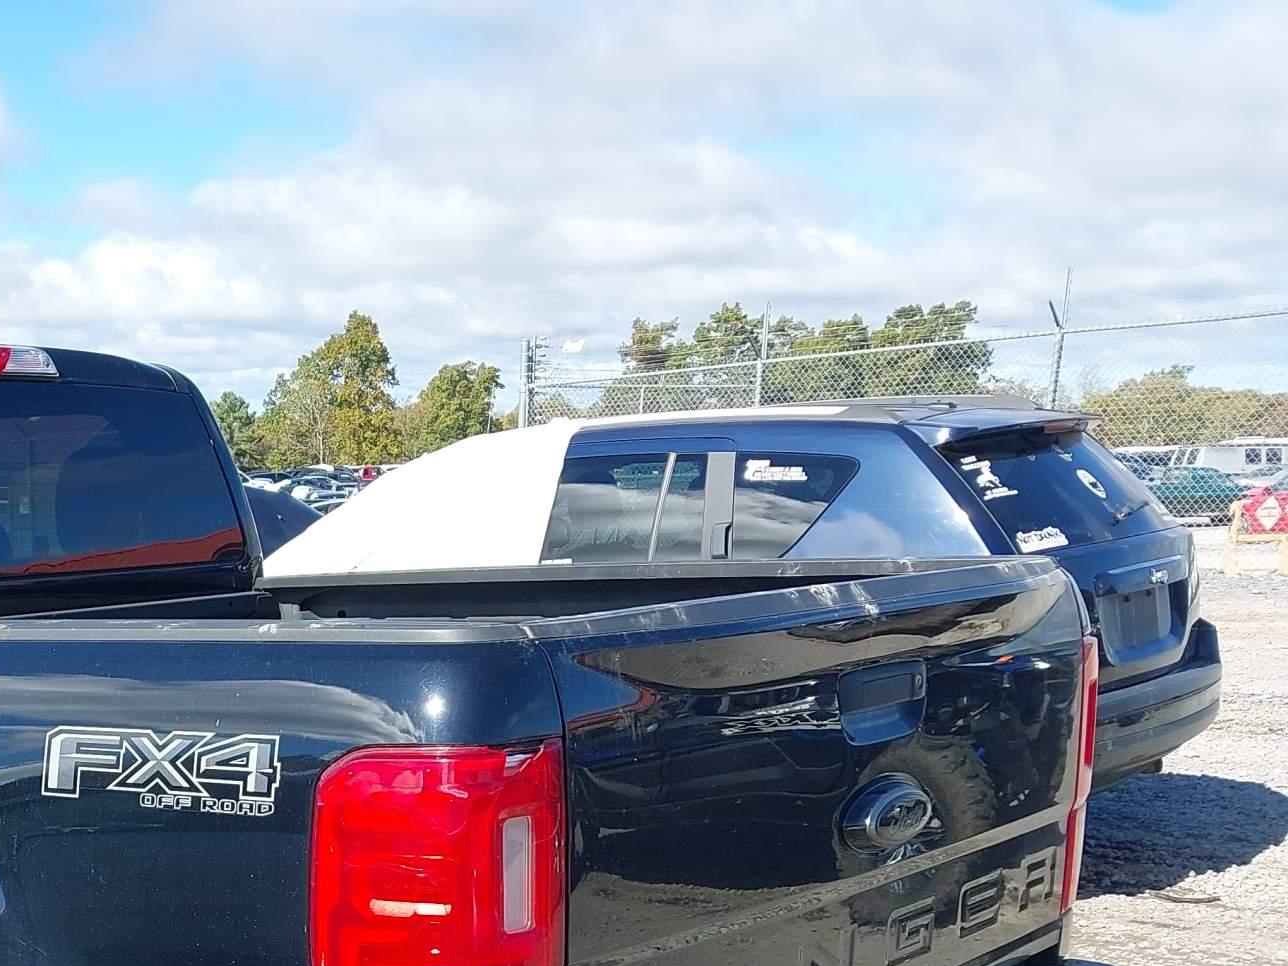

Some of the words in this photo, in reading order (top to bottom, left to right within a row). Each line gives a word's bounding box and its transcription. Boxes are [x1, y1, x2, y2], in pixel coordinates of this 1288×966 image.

[41, 725, 281, 801] FX4
[140, 793, 192, 809] OFF
[201, 798, 274, 816] ROAD
[886, 800, 925, 835] Ford
